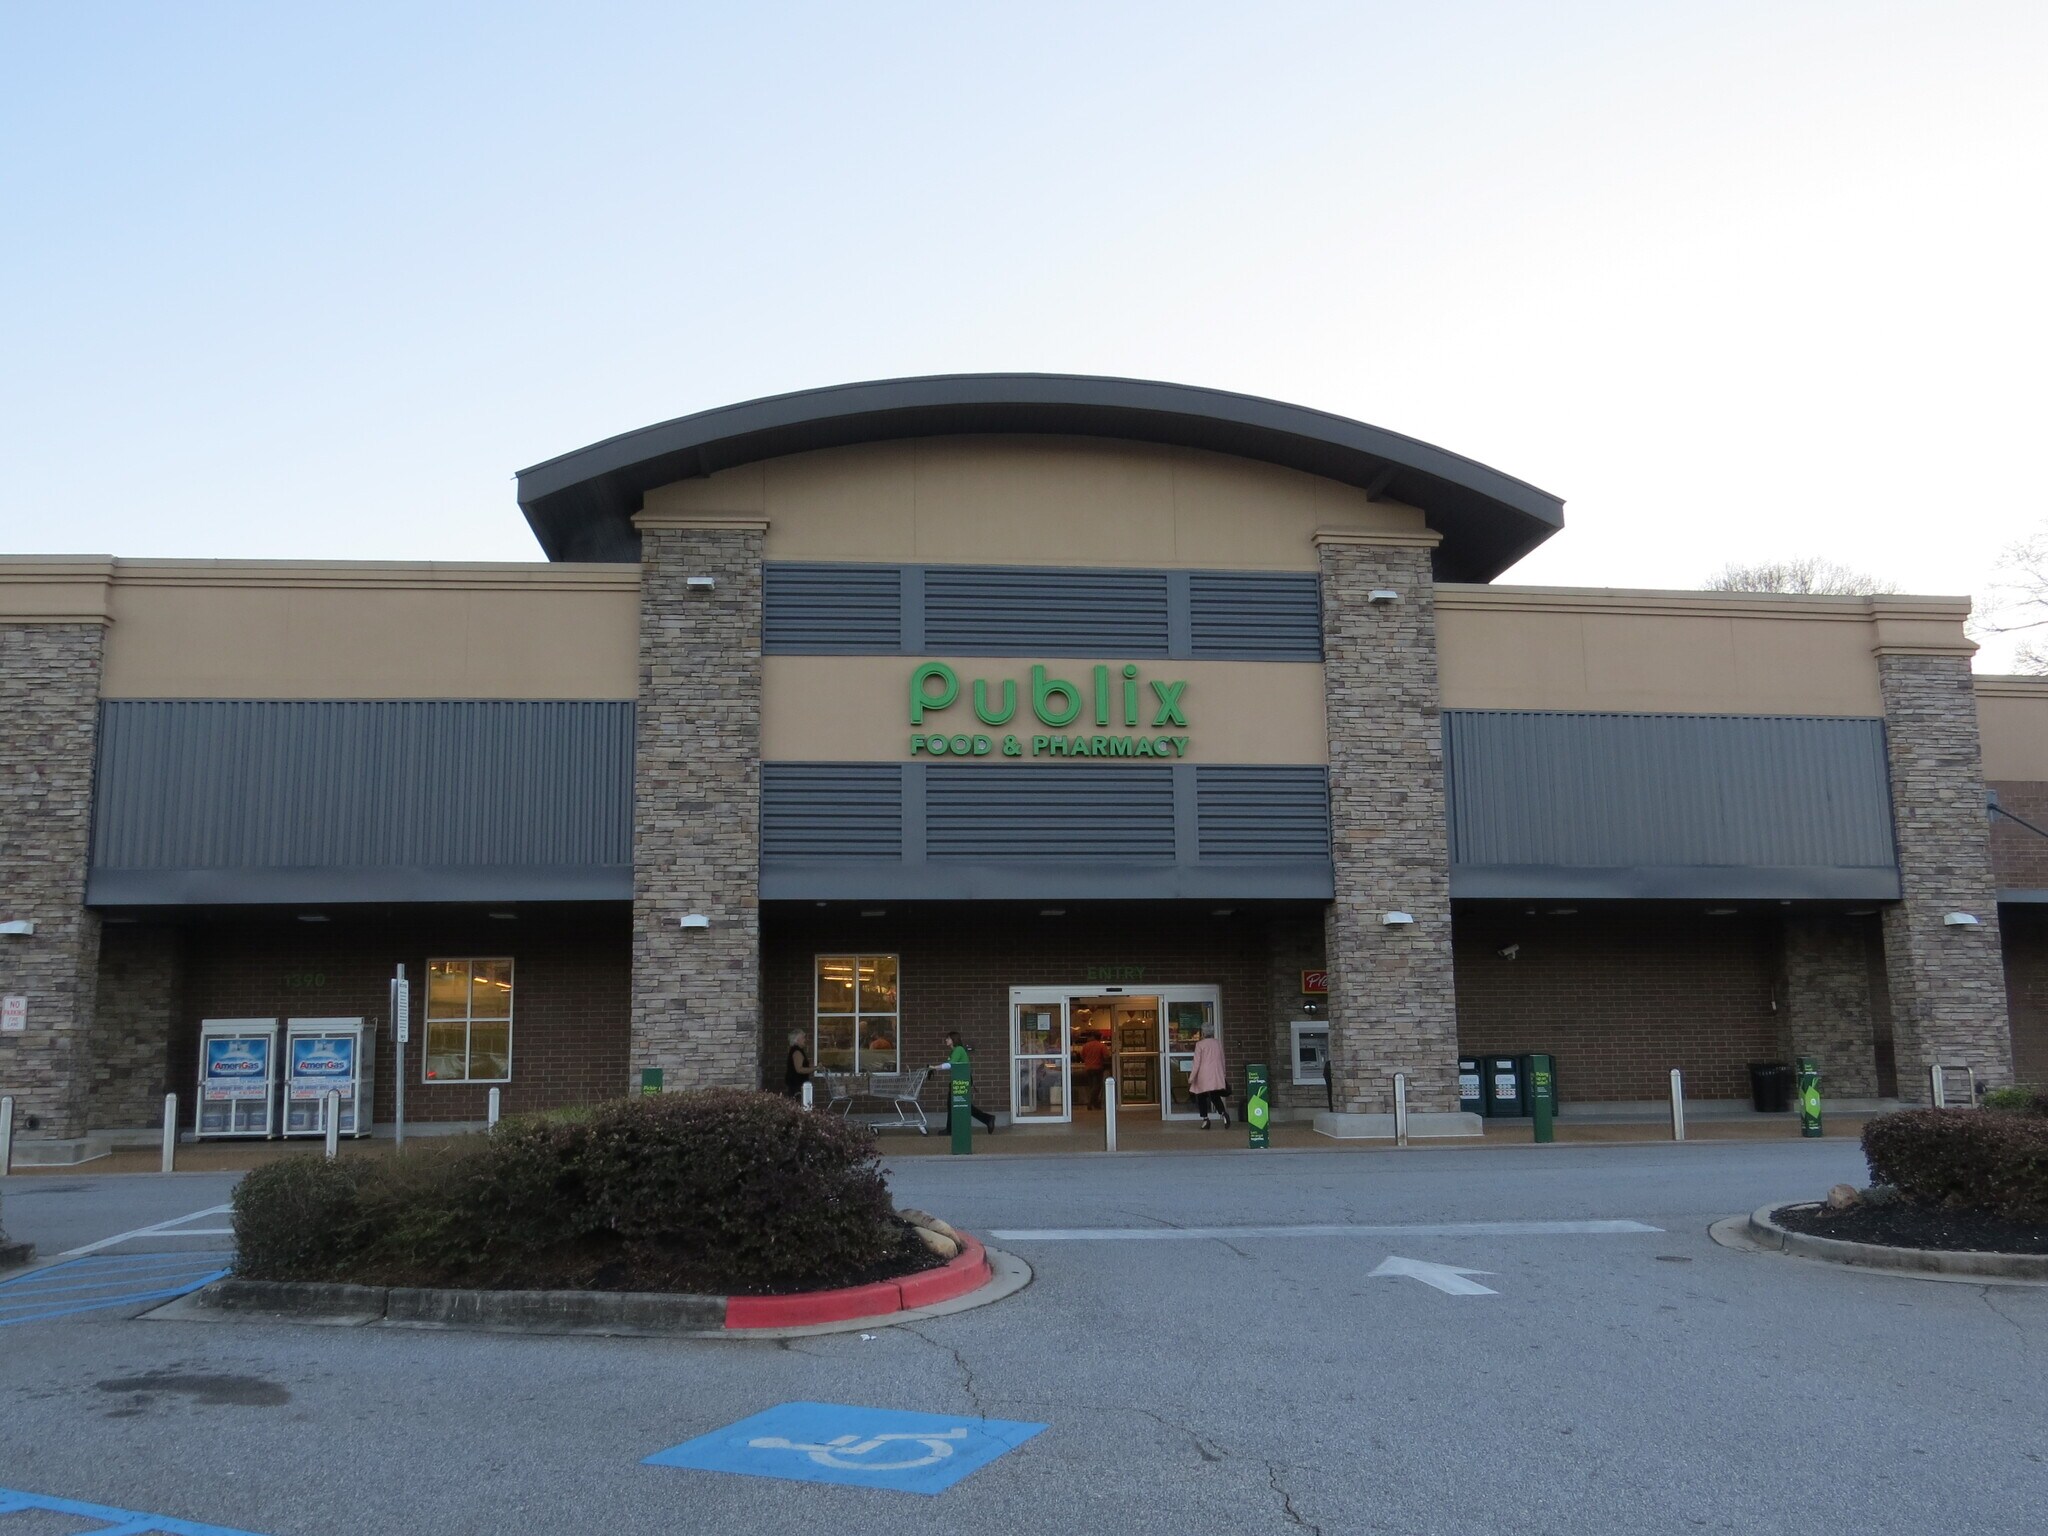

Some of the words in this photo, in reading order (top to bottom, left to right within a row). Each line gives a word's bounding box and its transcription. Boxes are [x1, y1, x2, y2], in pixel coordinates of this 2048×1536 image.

[910, 661, 1189, 727] Publix
[910, 733, 993, 756] FOOD
[1003, 735, 1022, 756] &
[1032, 735, 1190, 757] PHARMACY
[1087, 966, 1146, 980] ENTRY
[10, 1000, 20, 1008] NO
[214, 1061, 259, 1070] AmeriGas
[300, 1061, 344, 1070] AmeriGas
